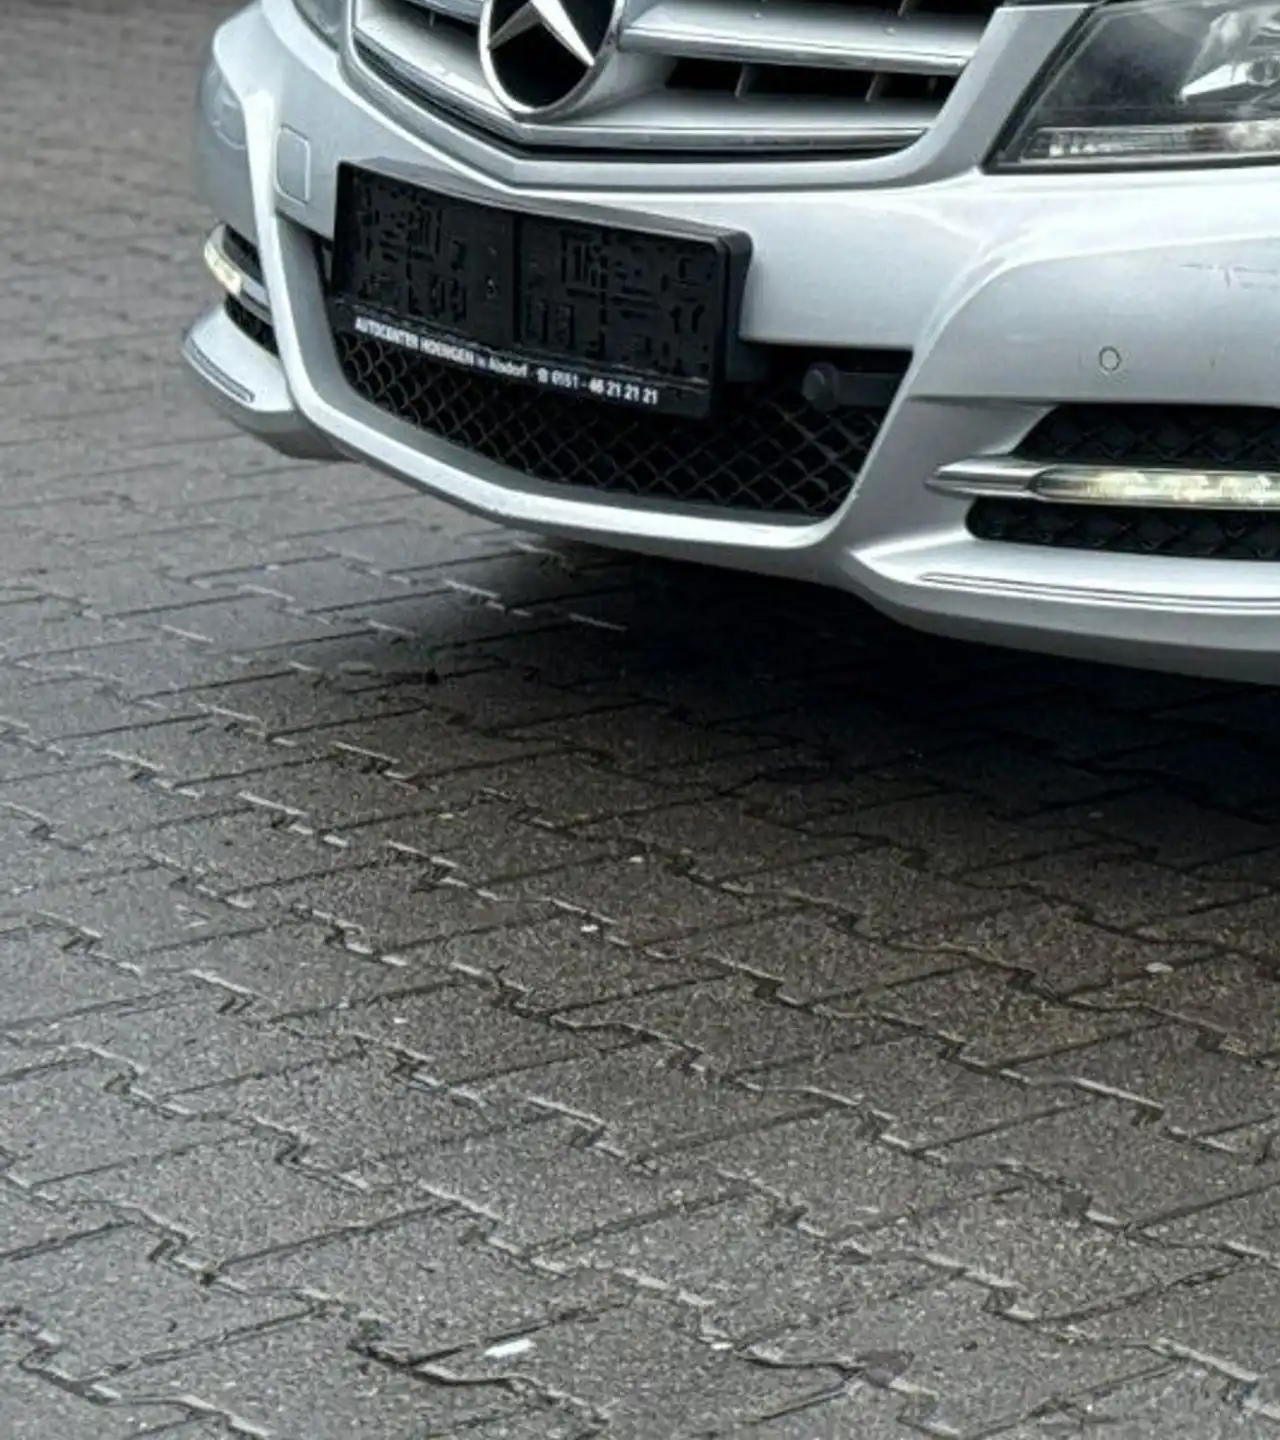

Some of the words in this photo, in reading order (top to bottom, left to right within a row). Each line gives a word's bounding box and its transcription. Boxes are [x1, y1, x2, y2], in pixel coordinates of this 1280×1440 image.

[552, 369, 579, 390] 0151
[607, 379, 621, 398] 21
[624, 383, 639, 402] 21
[642, 387, 658, 405] 21
